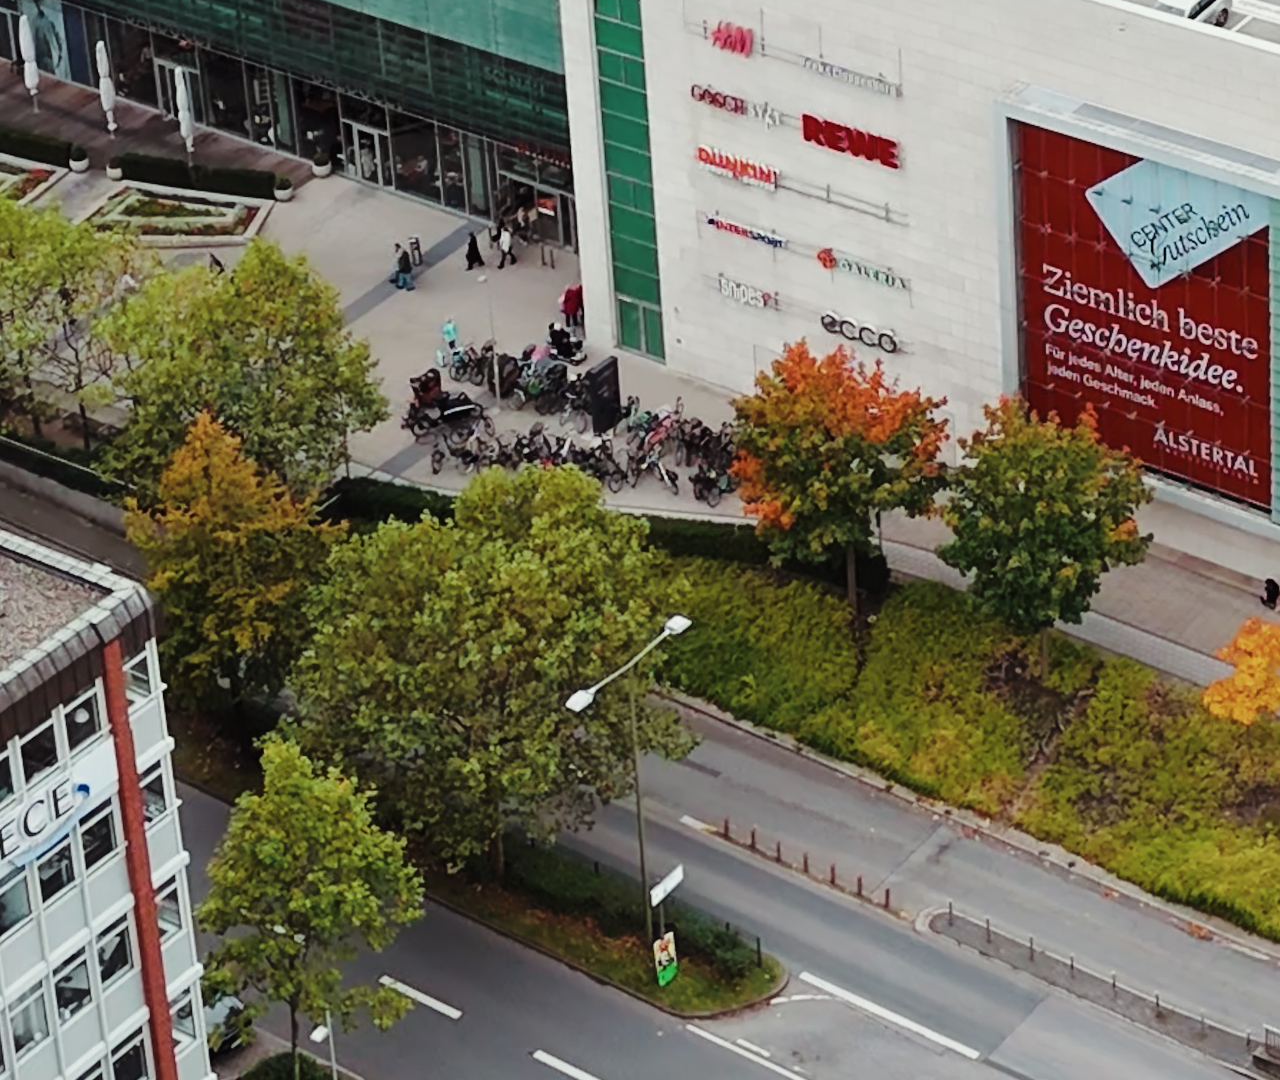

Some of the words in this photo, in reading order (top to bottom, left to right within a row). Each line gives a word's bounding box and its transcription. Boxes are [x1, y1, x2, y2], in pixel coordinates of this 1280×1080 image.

[691, 84, 747, 116] GOSCH
[801, 113, 900, 169] REWE
[1130, 202, 1198, 248] CENTER
[839, 258, 907, 289] GALERIA
[1042, 263, 1171, 333] Ziemlich
[1177, 307, 1259, 360] beste
[1044, 303, 1244, 394] Geschenkidee.
[1045, 343, 1066, 361] Für
[1153, 426, 1259, 477] ALSTERTAL
[0, 778, 74, 860] ECE
